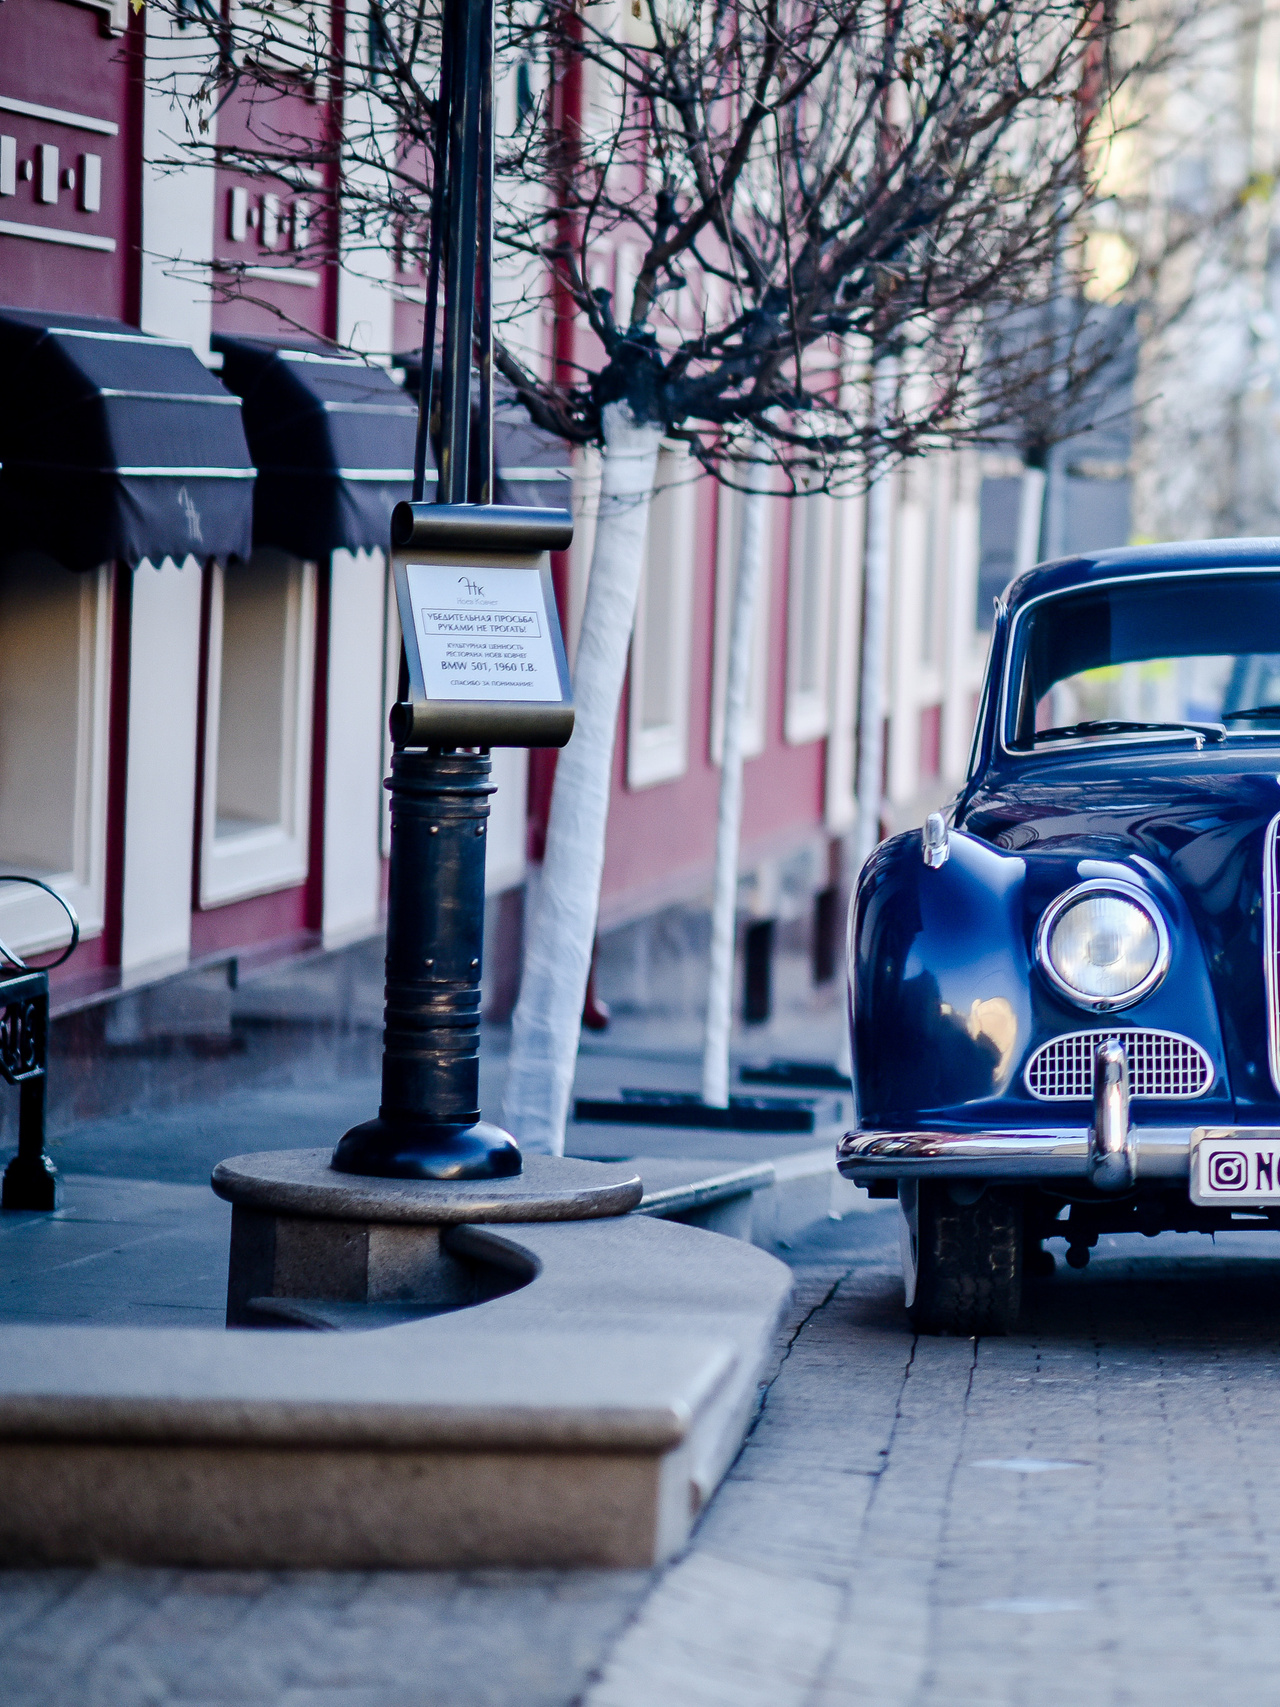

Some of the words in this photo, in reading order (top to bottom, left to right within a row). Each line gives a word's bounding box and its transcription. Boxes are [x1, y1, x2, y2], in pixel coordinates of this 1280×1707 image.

[427, 613, 492, 623] УБЕДИТЕЛЬНАЯ
[494, 614, 534, 623] ПРОСЬБА
[437, 623, 474, 632] РУКАМИ
[476, 624, 488, 632] НЕ
[490, 624, 527, 633] ТРОГАТЬ!
[441, 661, 467, 671] BMW
[471, 662, 492, 673] 501,
[494, 662, 517, 672] 1960
